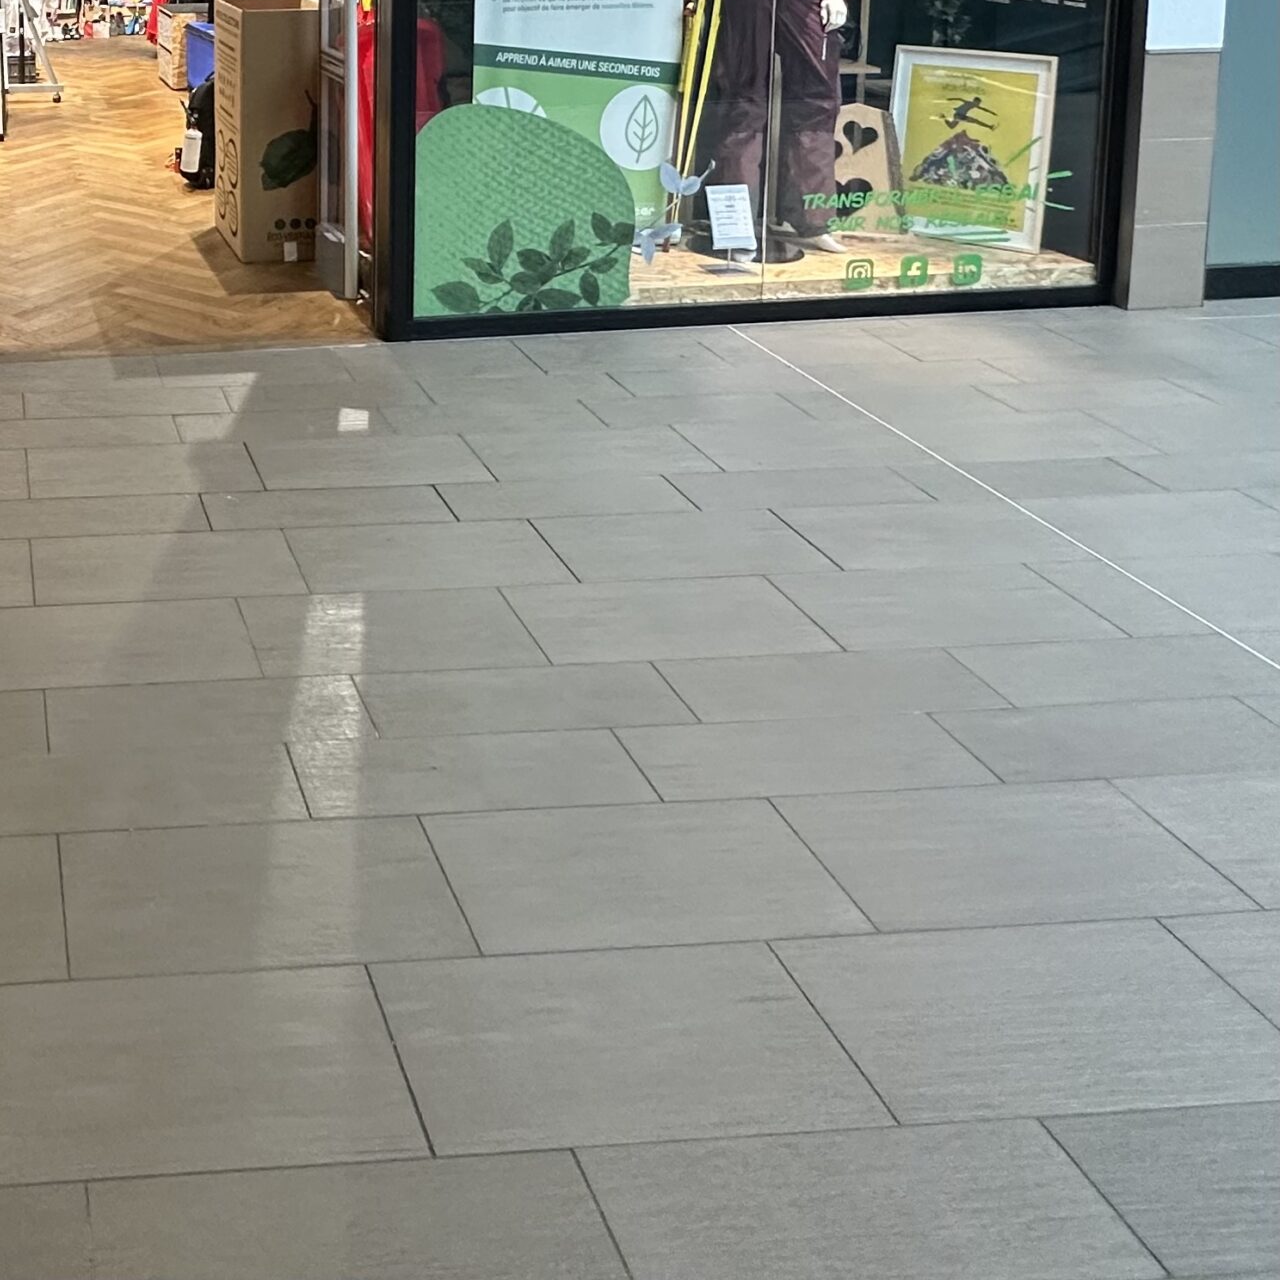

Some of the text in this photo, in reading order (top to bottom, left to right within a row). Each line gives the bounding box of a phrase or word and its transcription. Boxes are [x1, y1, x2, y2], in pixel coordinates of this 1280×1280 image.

[496, 51, 537, 65] APPREND
[548, 57, 577, 70] AIMER
[578, 60, 596, 71] UNE
[598, 63, 640, 76] SECONDE
[640, 66, 661, 78] FOIS
